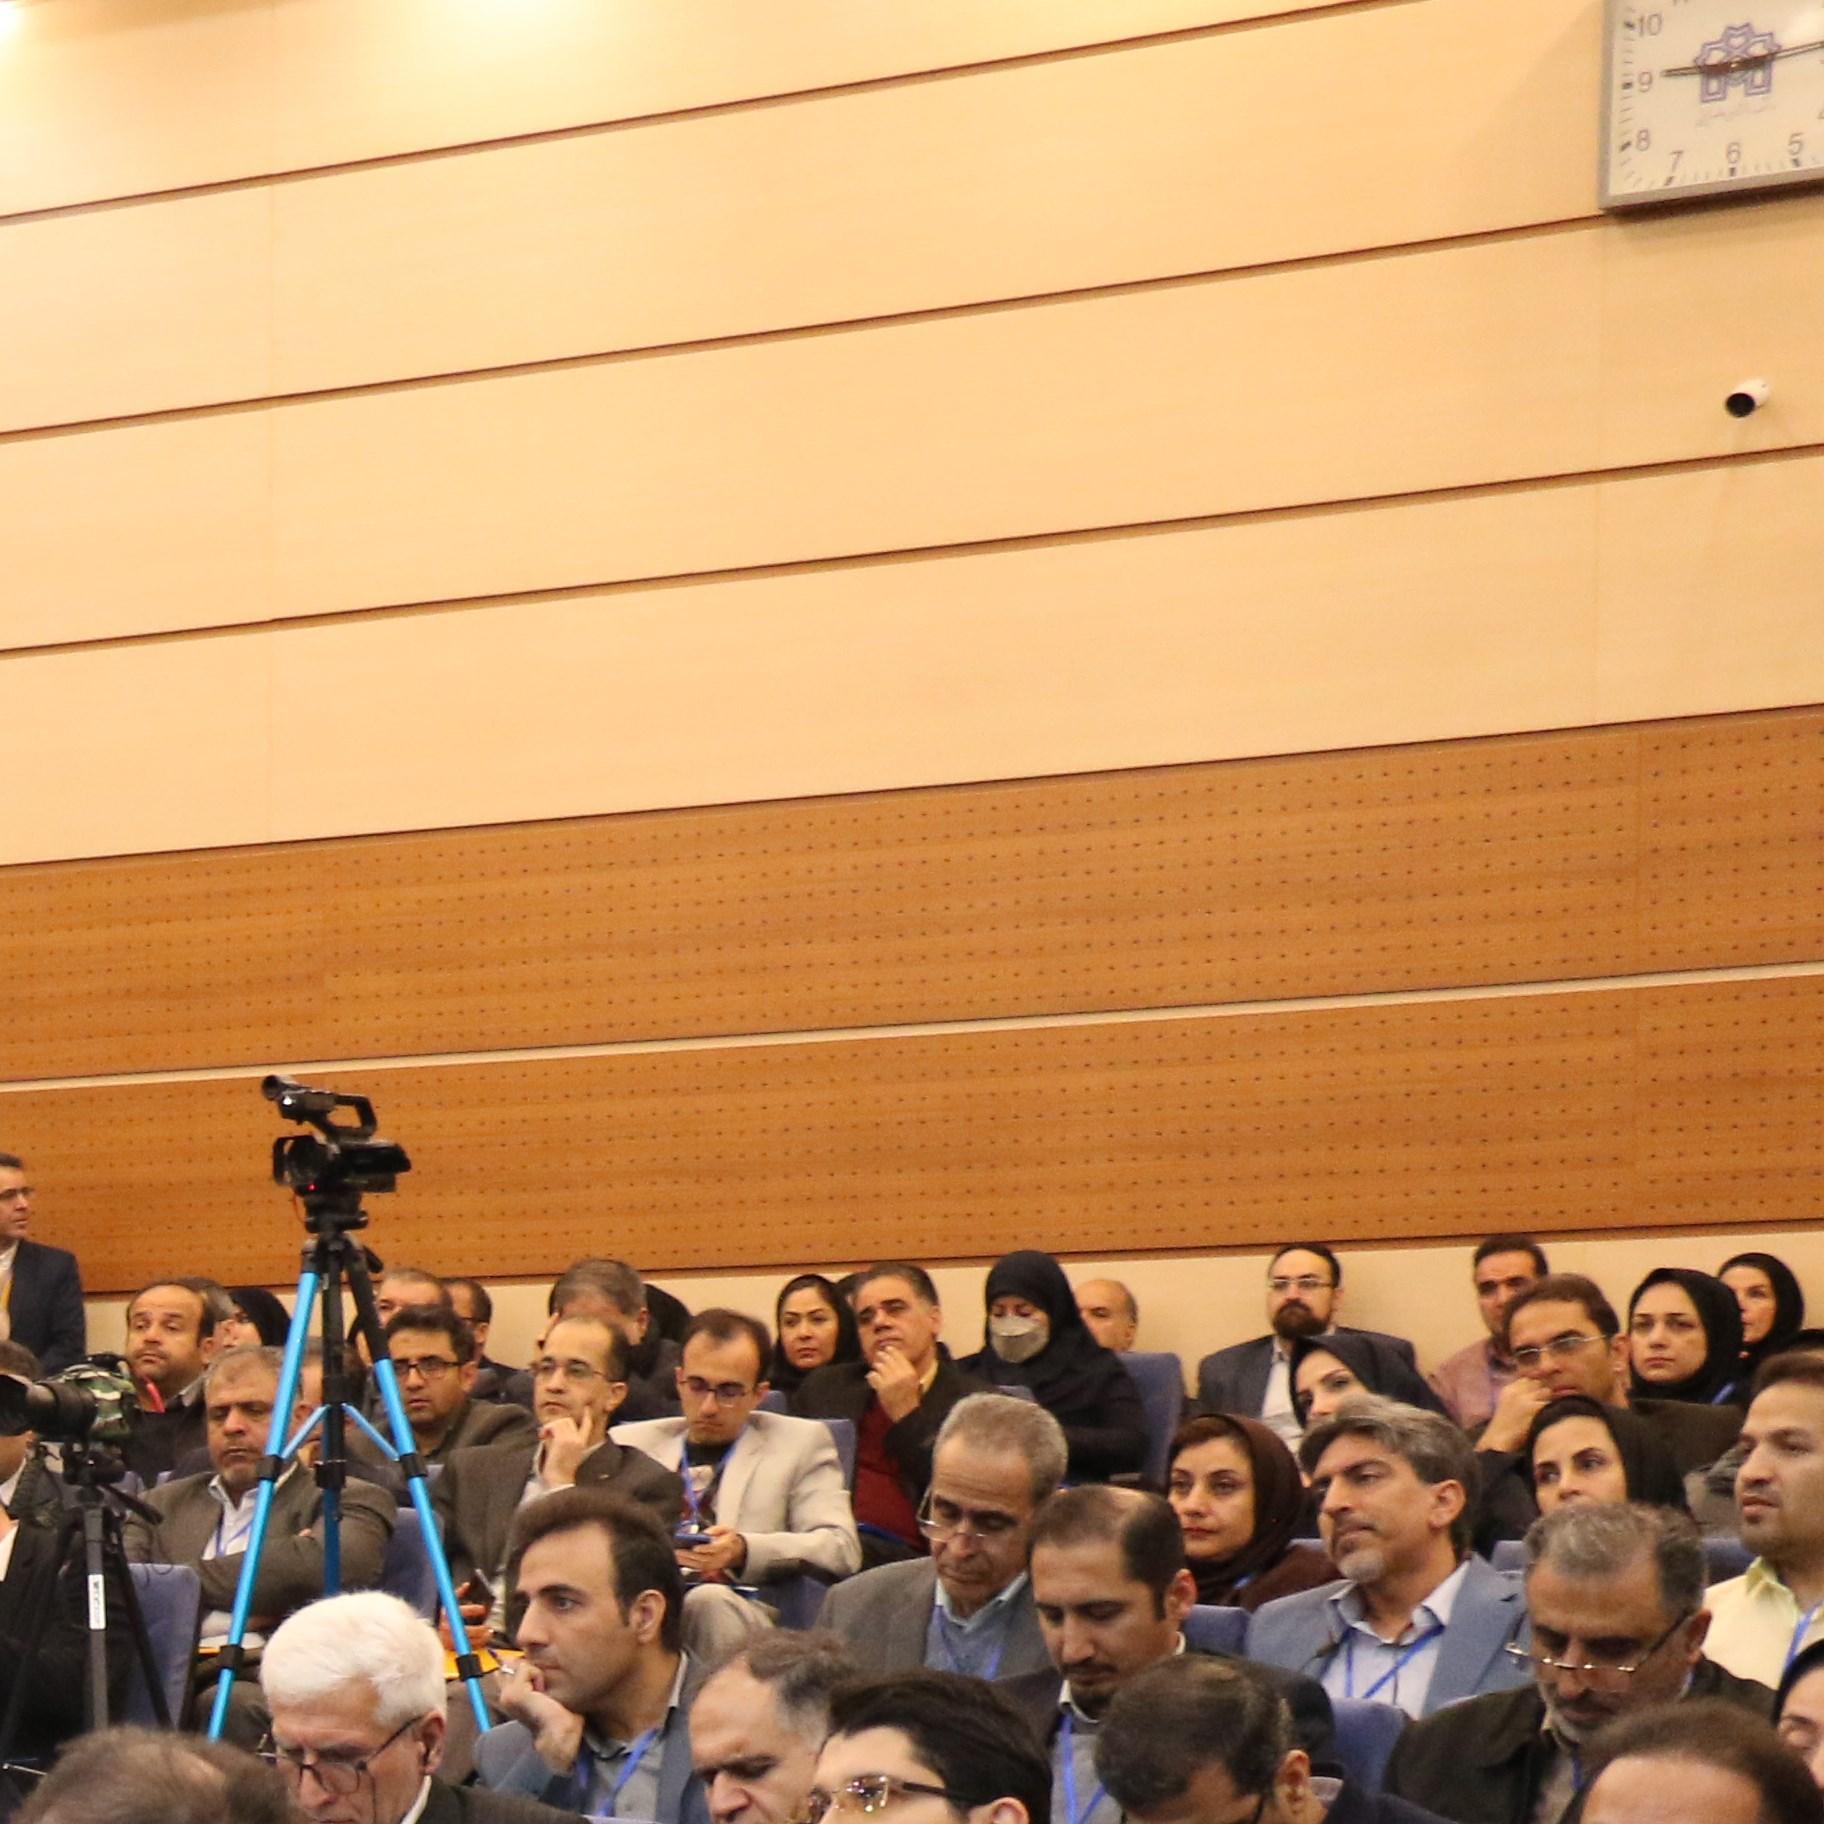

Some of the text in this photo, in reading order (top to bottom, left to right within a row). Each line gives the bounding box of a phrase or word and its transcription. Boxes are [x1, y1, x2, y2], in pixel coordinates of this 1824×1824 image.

[1637, 13, 1663, 37] 10
[1638, 71, 1653, 93] 9
[1636, 129, 1651, 152] 8
[1787, 132, 1804, 156] 5
[1669, 150, 1684, 174] 7
[1726, 141, 1741, 165] 6
